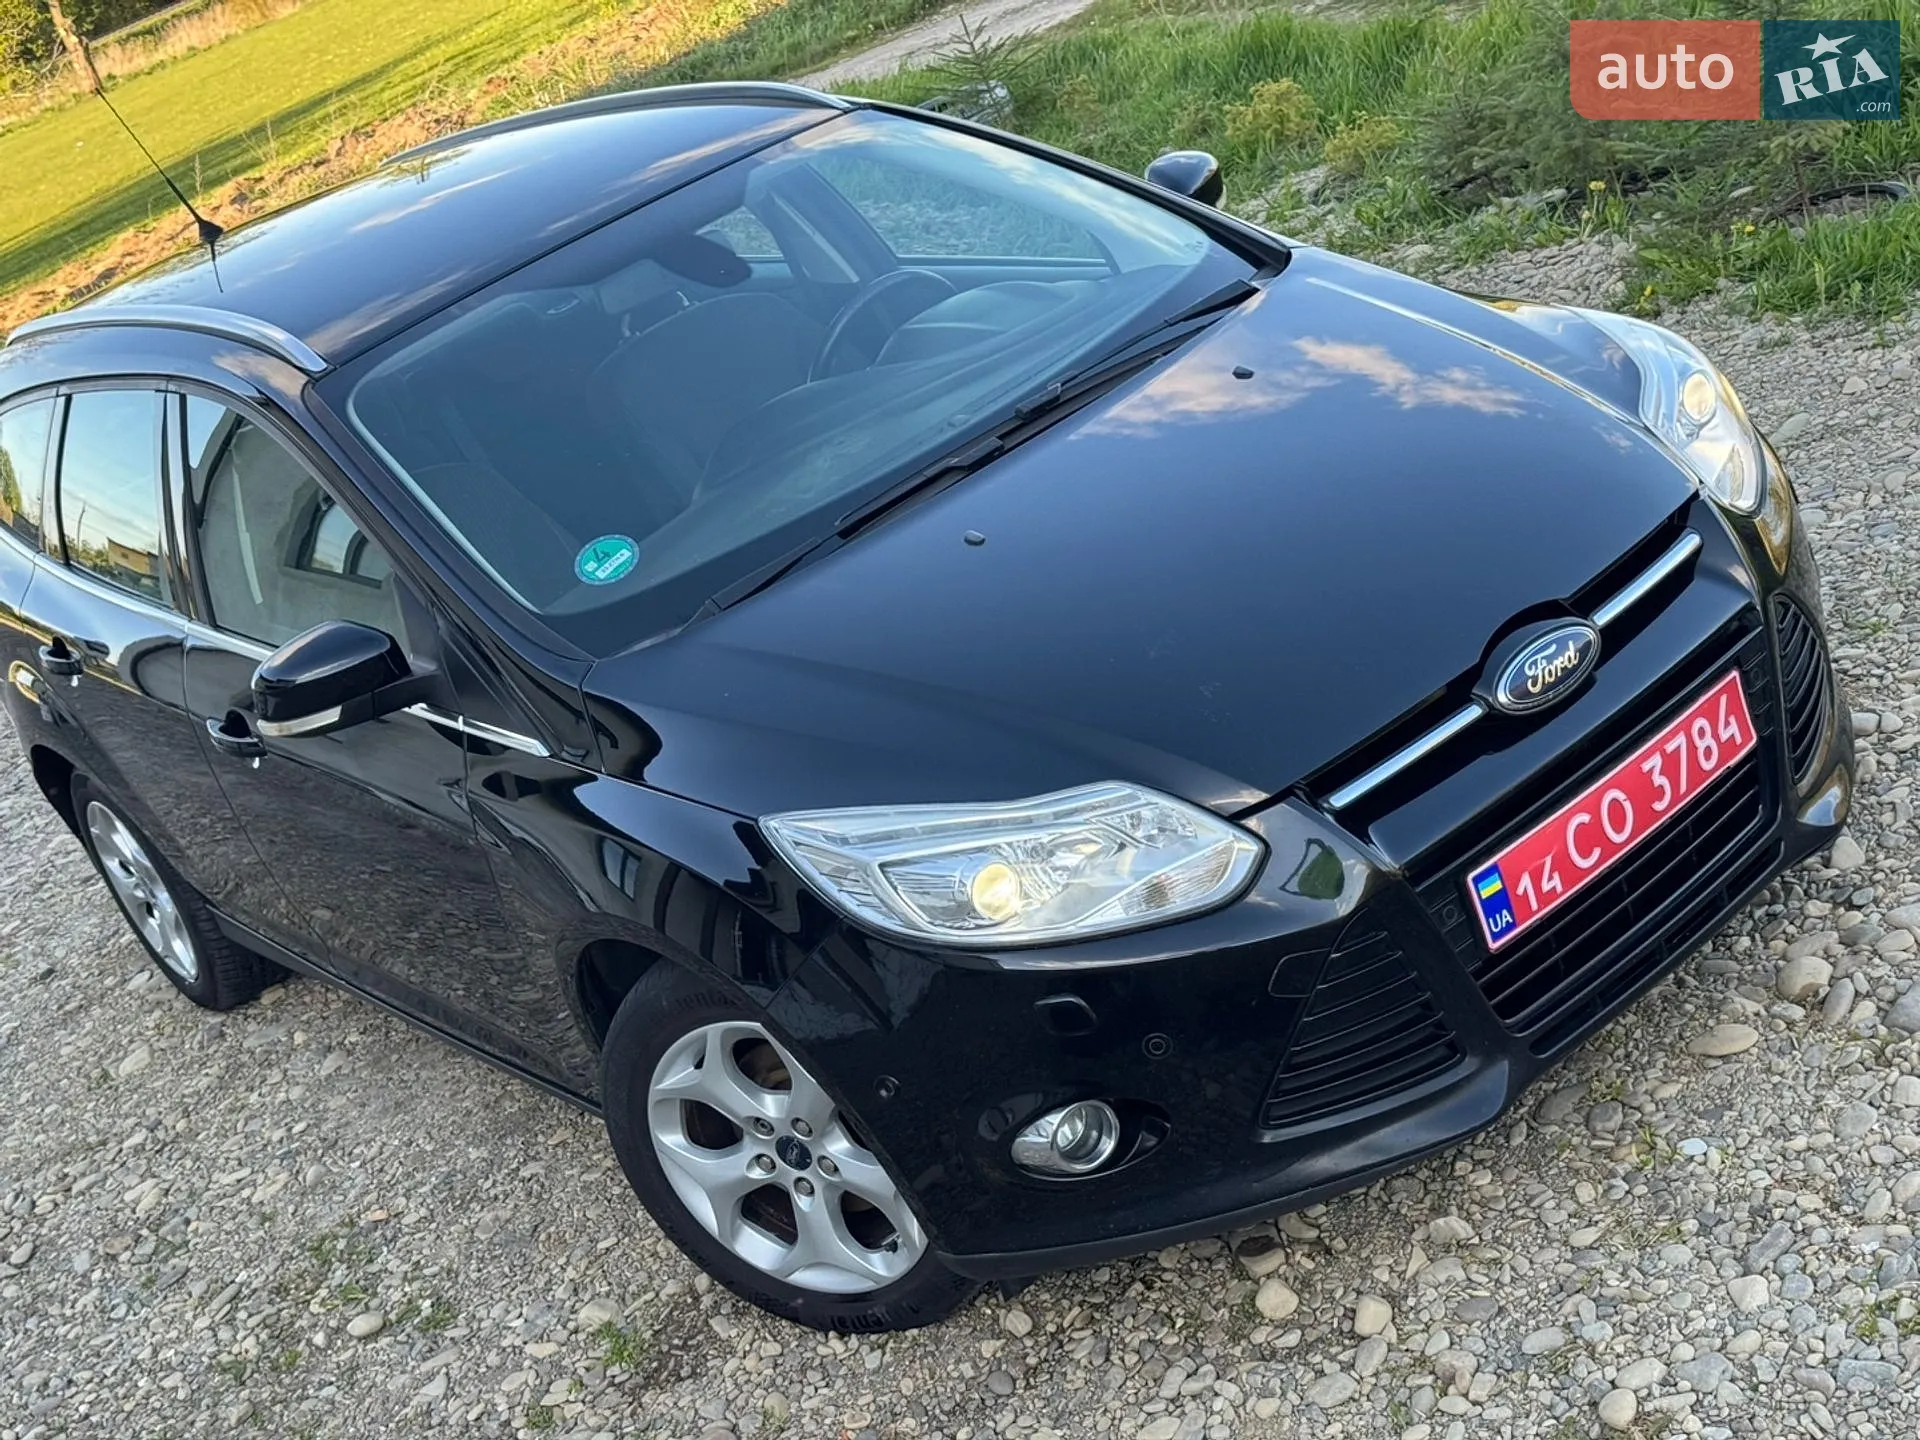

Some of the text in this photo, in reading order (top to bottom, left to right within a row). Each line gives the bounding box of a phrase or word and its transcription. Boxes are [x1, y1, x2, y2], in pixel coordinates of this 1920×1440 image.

[1524, 640, 1579, 694] Ford
[1515, 692, 1743, 912] 14 CO 3784
[1489, 912, 1513, 933] UA
